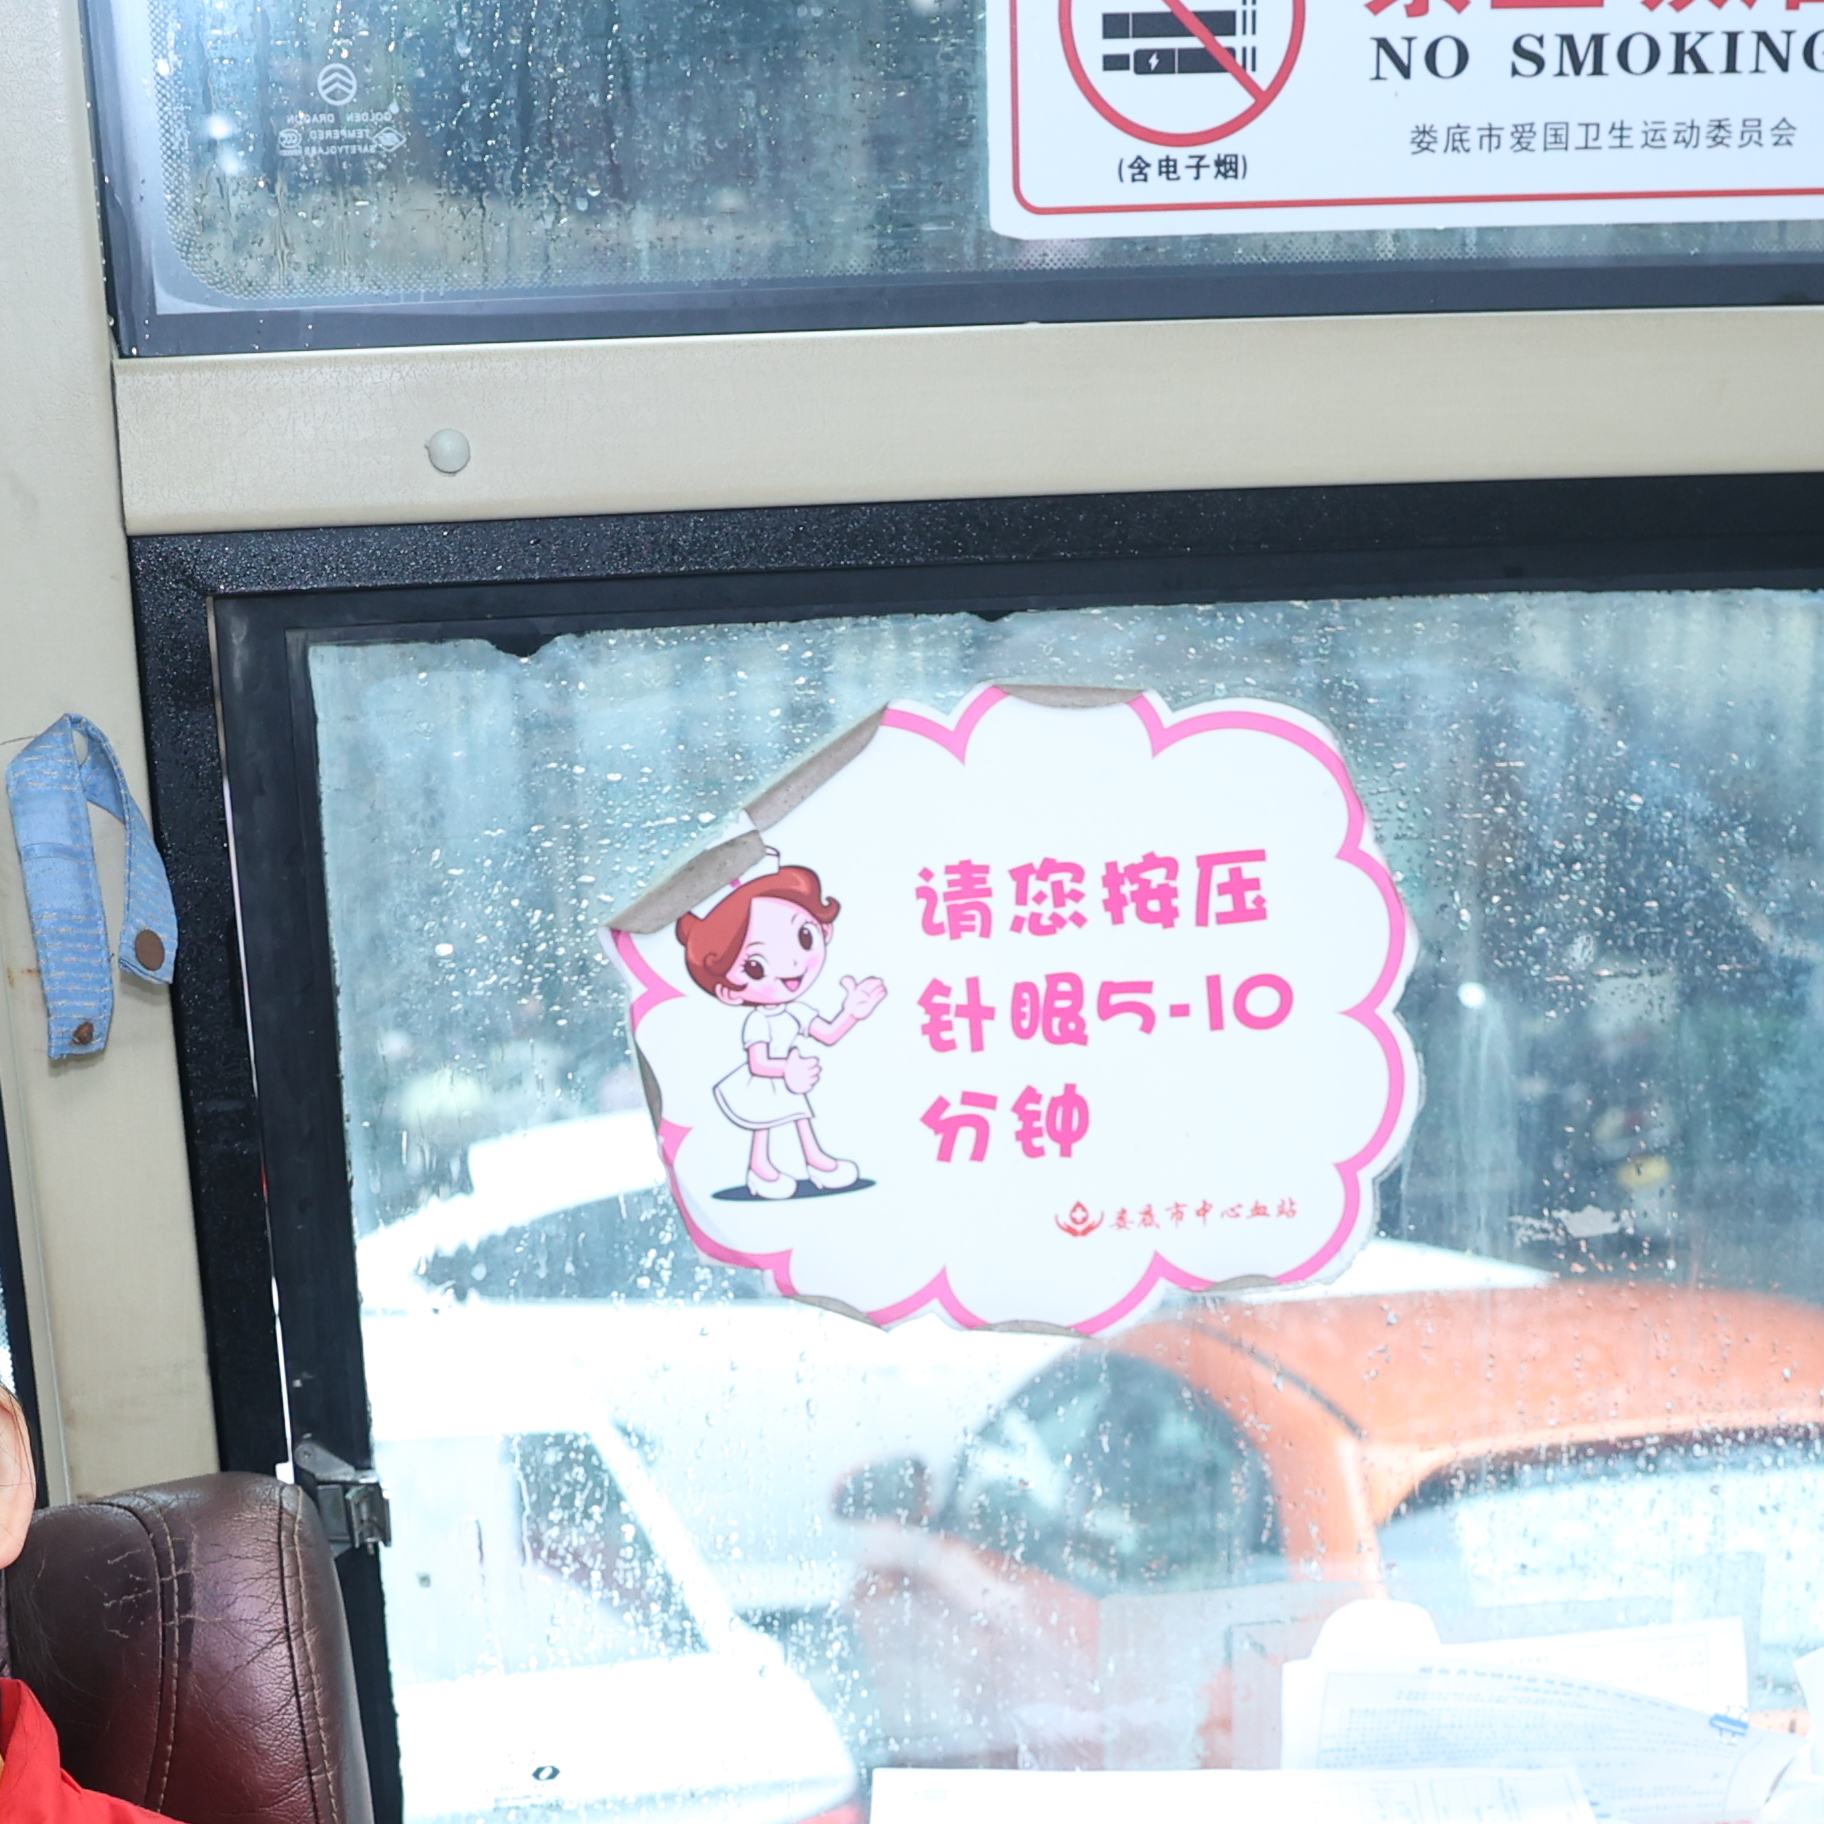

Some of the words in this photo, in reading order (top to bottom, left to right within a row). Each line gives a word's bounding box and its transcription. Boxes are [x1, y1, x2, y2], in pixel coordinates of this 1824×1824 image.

[1370, 34, 1470, 81] NO
[1409, 117, 1799, 155] 娄底市爱国卫生运动委员会
[915, 848, 1269, 941] 请您按压
[919, 971, 1294, 1054] 针眼5-10
[920, 1081, 1091, 1164] 分钟
[1108, 1197, 1300, 1234] 娄底市中心血站
